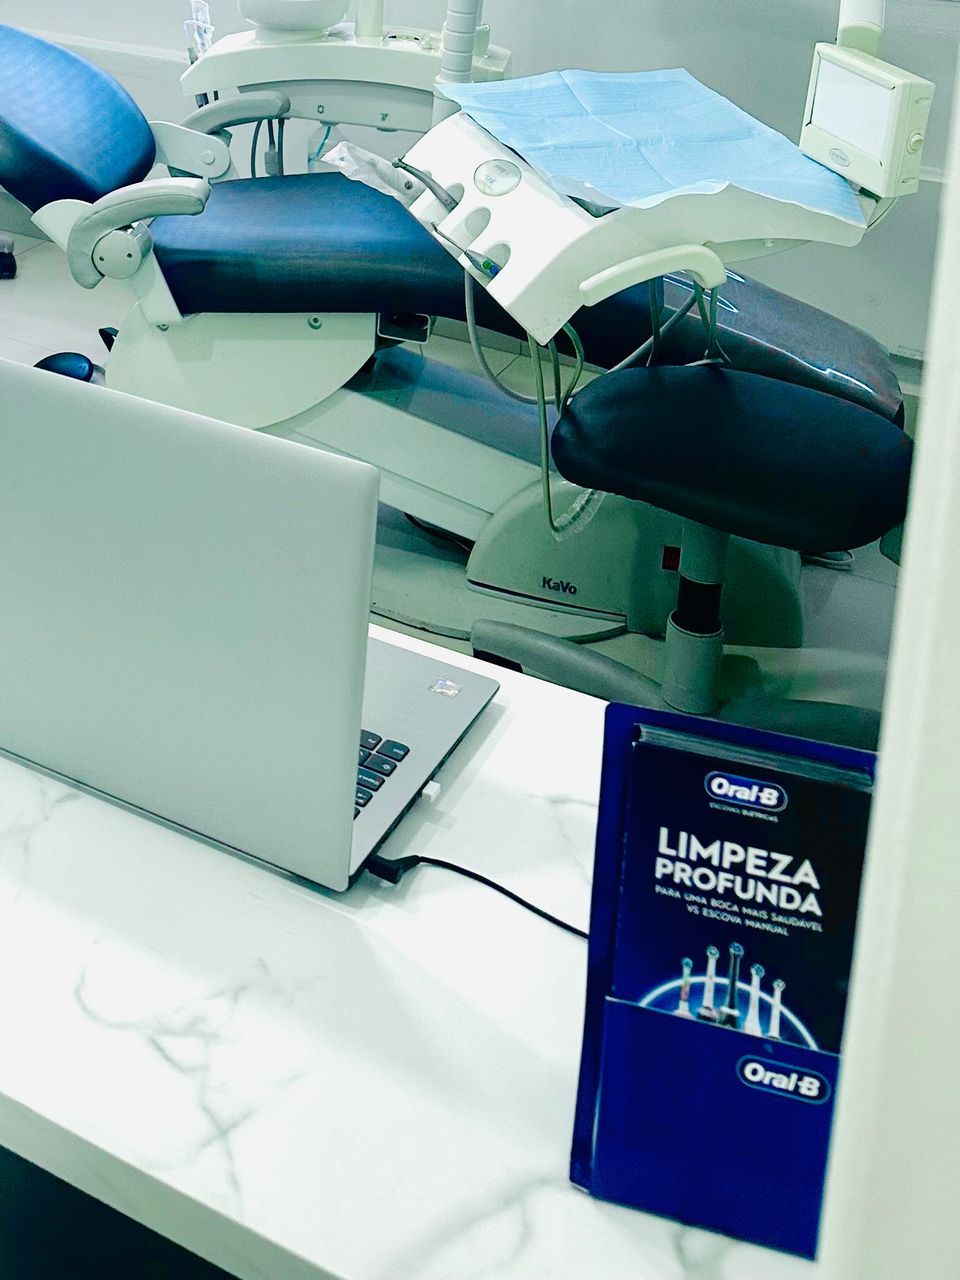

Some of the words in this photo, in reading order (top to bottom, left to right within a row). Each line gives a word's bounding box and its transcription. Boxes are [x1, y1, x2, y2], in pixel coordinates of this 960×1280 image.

[542, 576, 578, 595] KaVo
[710, 776, 780, 807] Oral-B
[657, 826, 821, 890] LIMPEZA
[654, 856, 824, 917] PROFUNDA
[654, 884, 682, 899] PARA
[684, 891, 708, 905] UMA
[710, 897, 740, 913] BOCA
[742, 906, 769, 920] MAIS
[686, 903, 700, 915] VS
[702, 907, 742, 925] ESCOVA
[744, 919, 790, 936] MANUAL
[743, 1061, 821, 1097] Oral-B
